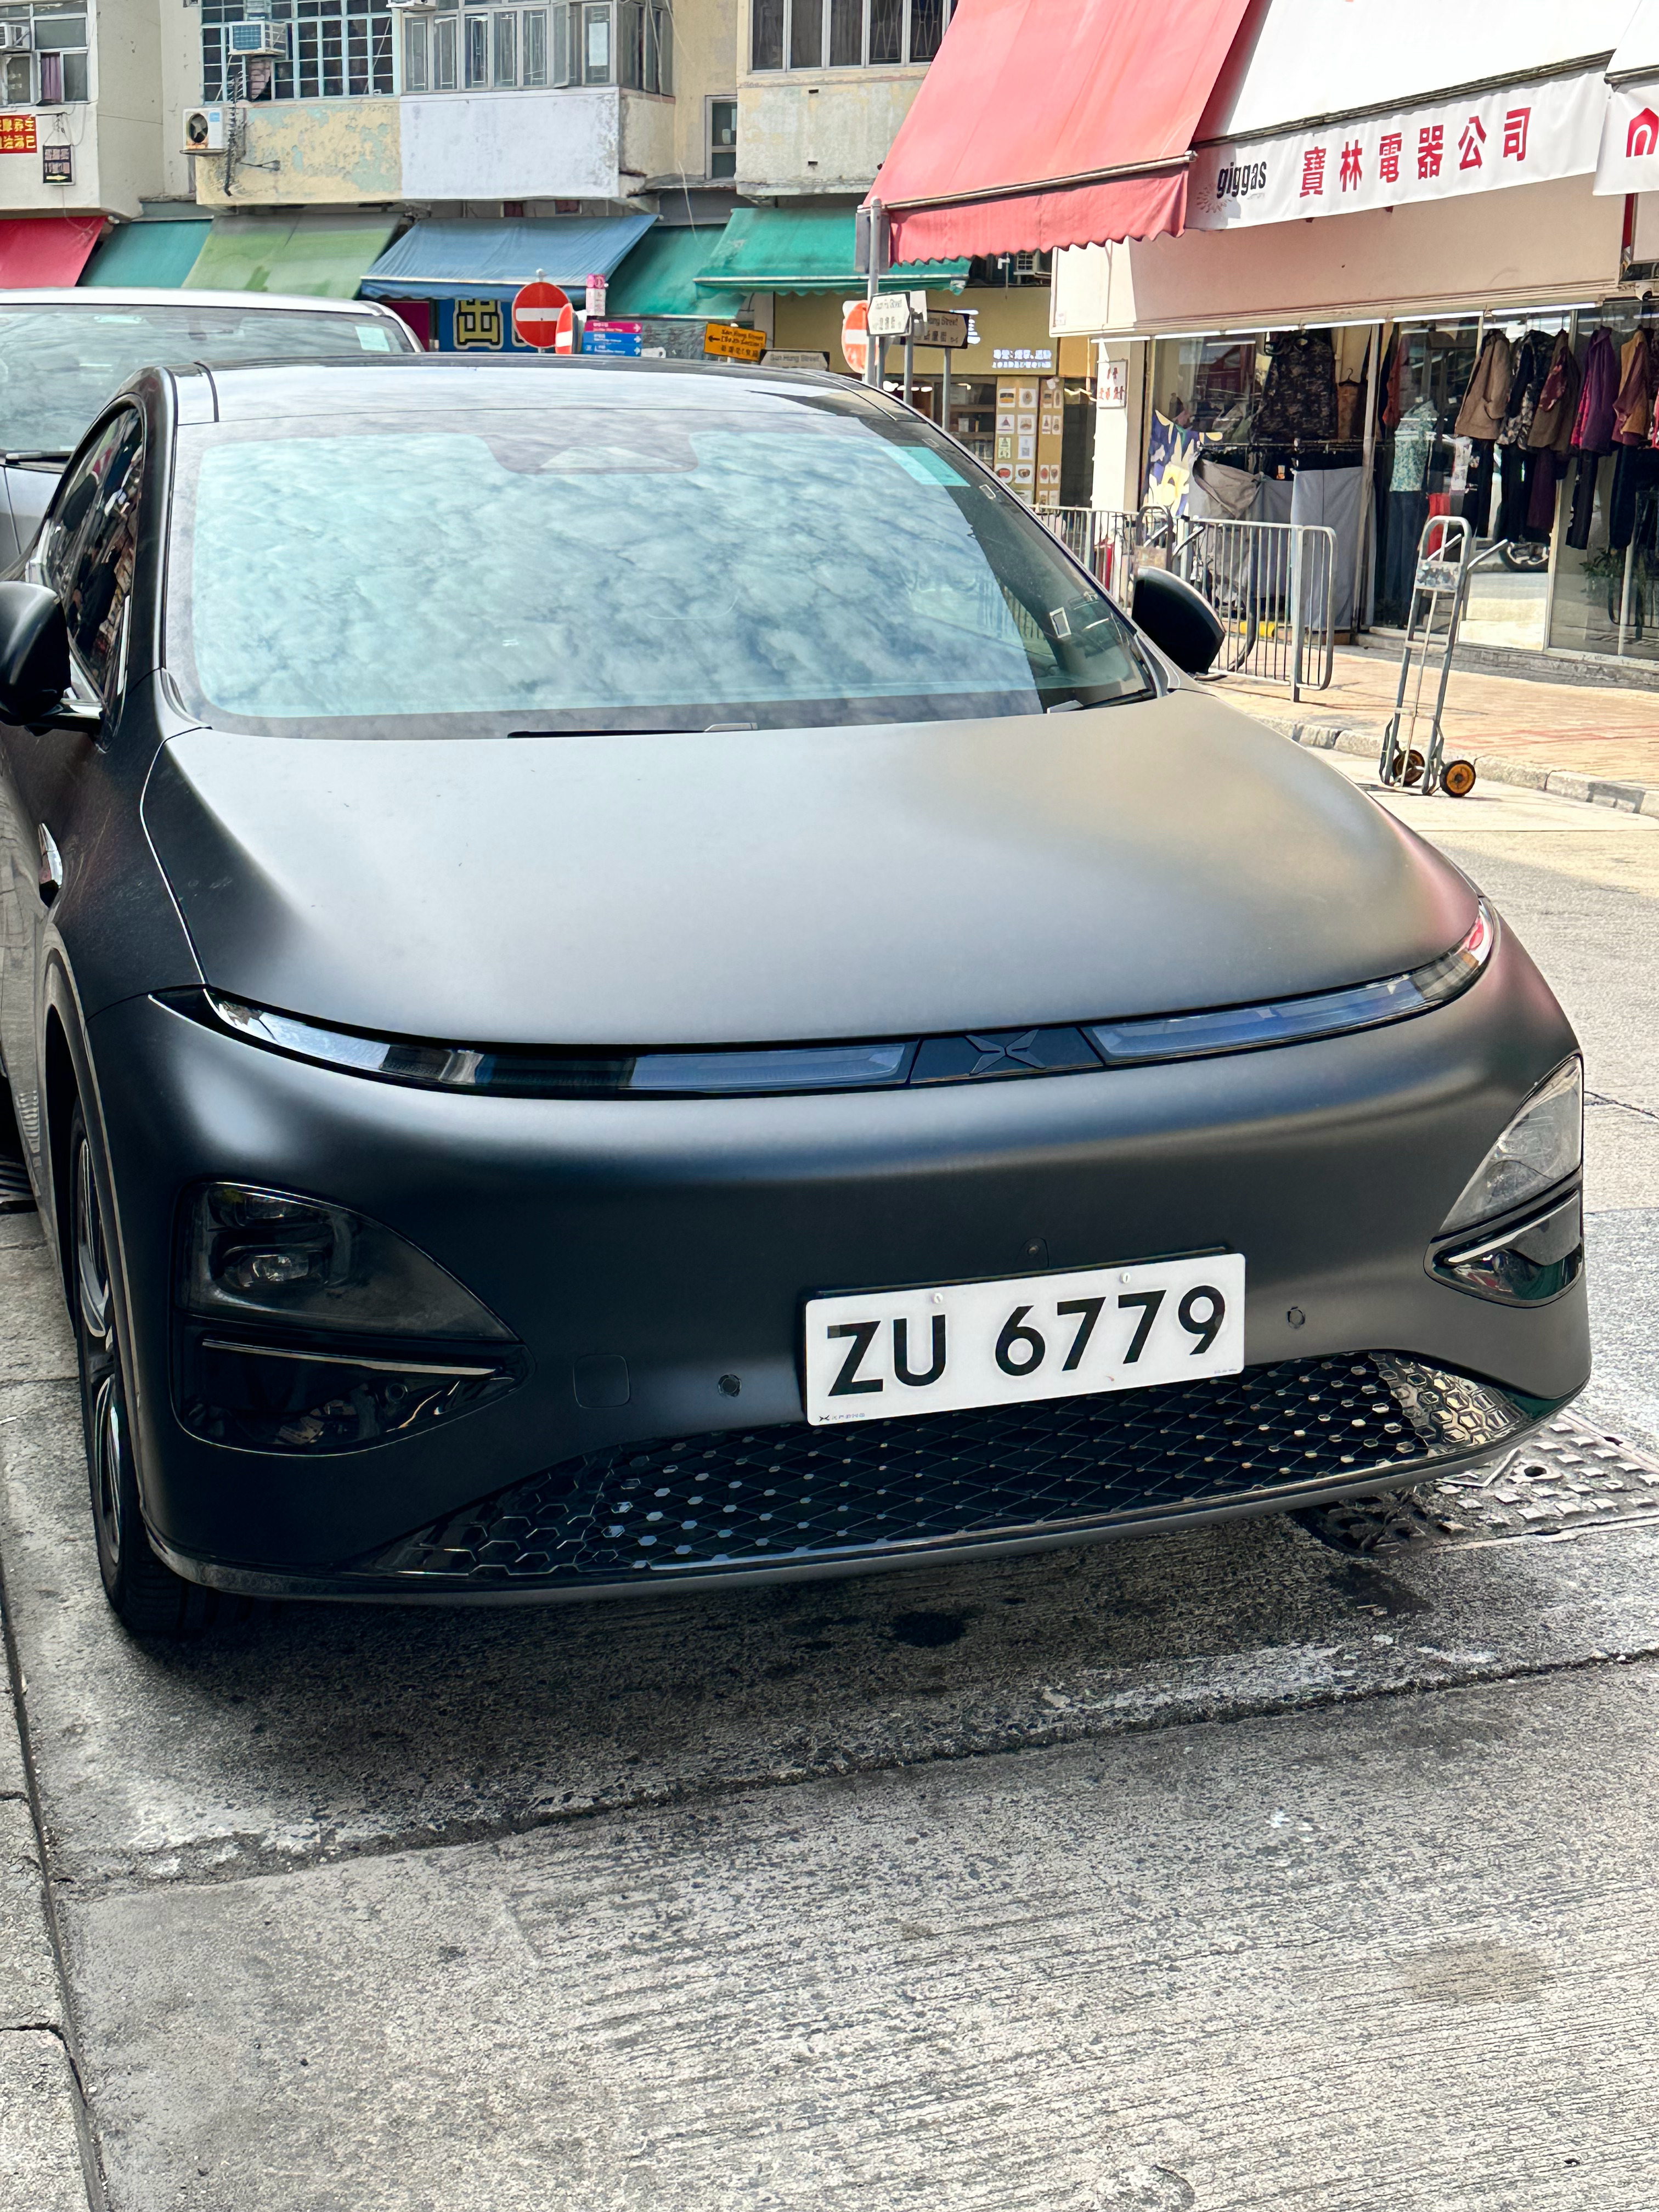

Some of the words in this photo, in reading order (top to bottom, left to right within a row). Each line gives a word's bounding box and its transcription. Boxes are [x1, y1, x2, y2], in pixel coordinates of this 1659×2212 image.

[1217, 161, 1267, 199] giggas
[1300, 107, 1531, 198] 寶林電器公司
[827, 1314, 946, 1397] ZU
[995, 1285, 1226, 1376] 6779
